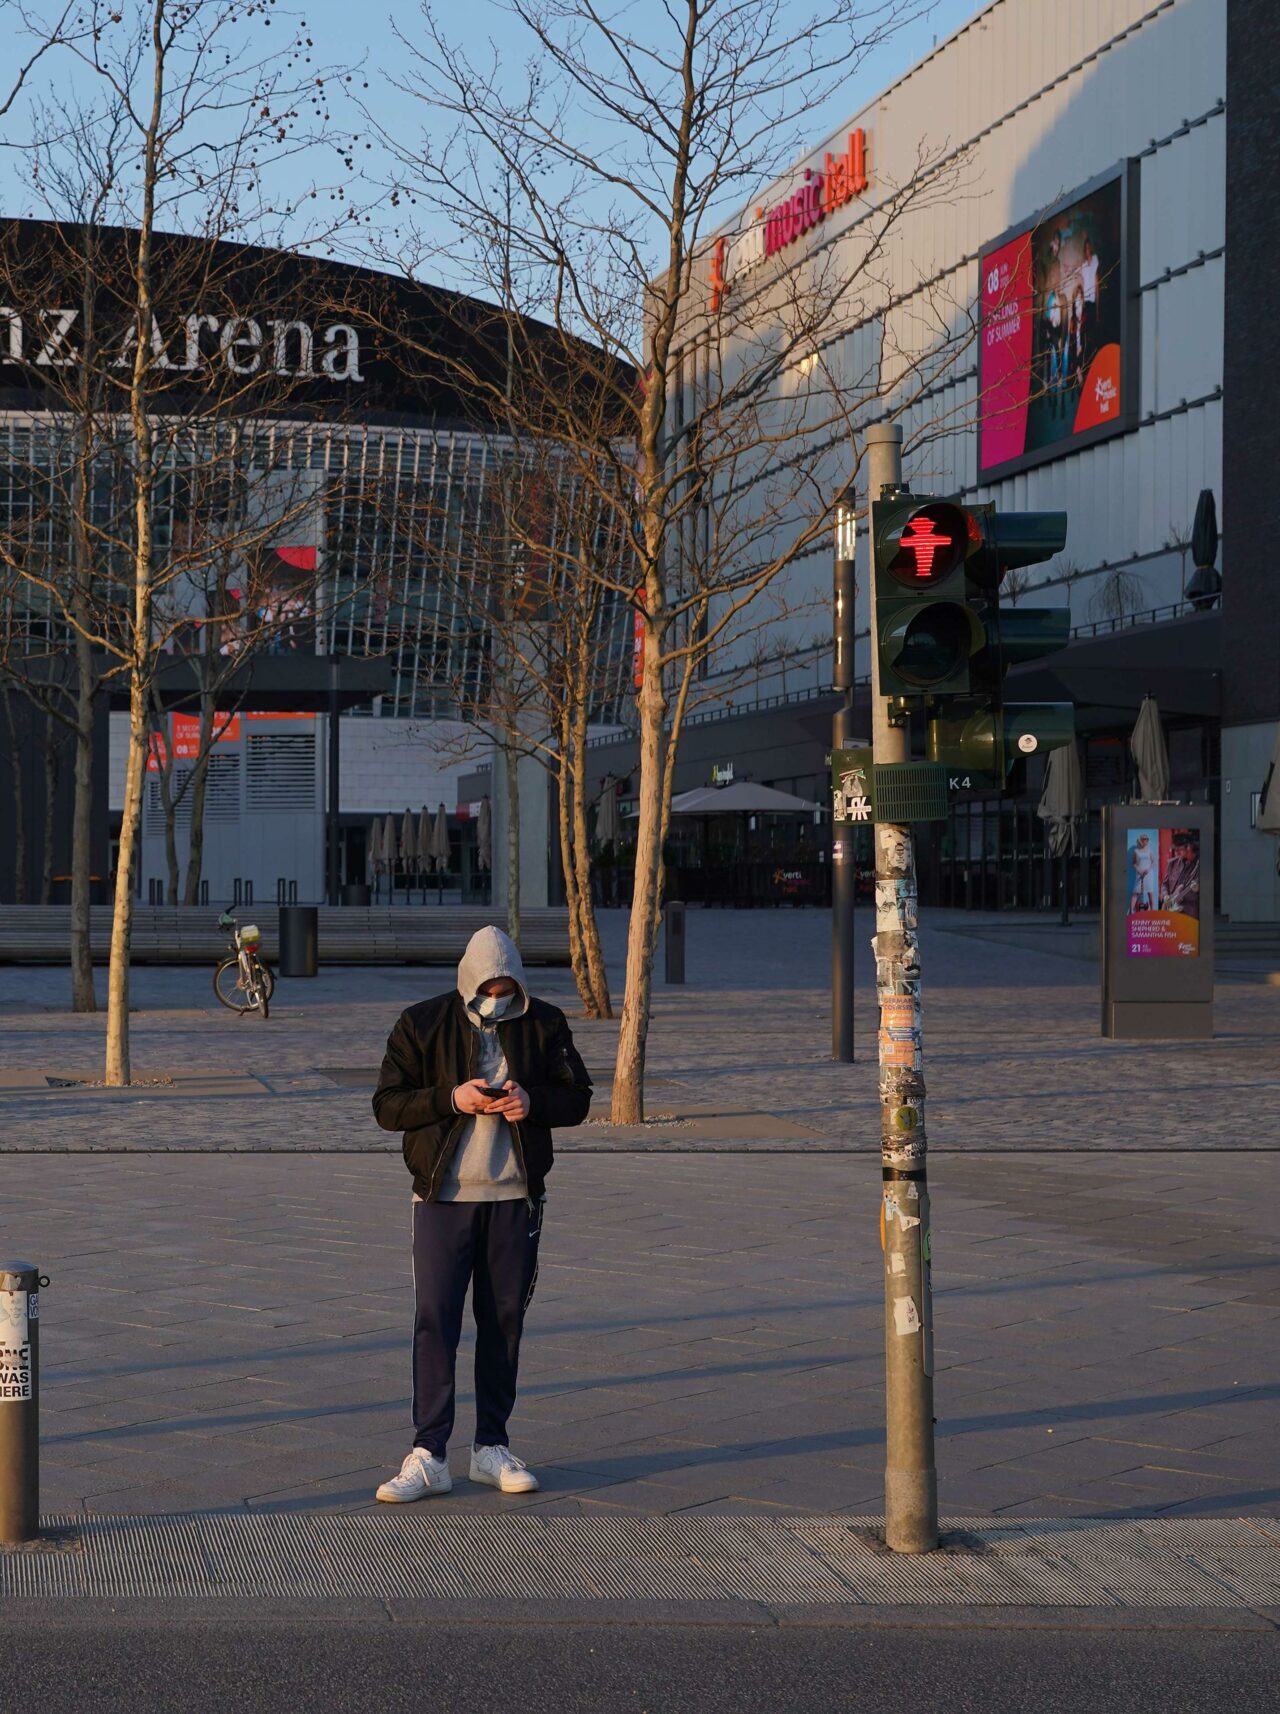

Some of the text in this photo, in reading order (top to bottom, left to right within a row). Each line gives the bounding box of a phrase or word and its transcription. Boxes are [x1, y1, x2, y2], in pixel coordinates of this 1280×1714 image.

[765, 168, 824, 257] music
[824, 127, 867, 214] hall
[987, 268, 999, 294] 08
[108, 304, 365, 383] Arena
[987, 329, 994, 346] OF
[995, 315, 1021, 342] SUMMER
[783, 870, 802, 880] verti
[1131, 944, 1141, 953] 21
